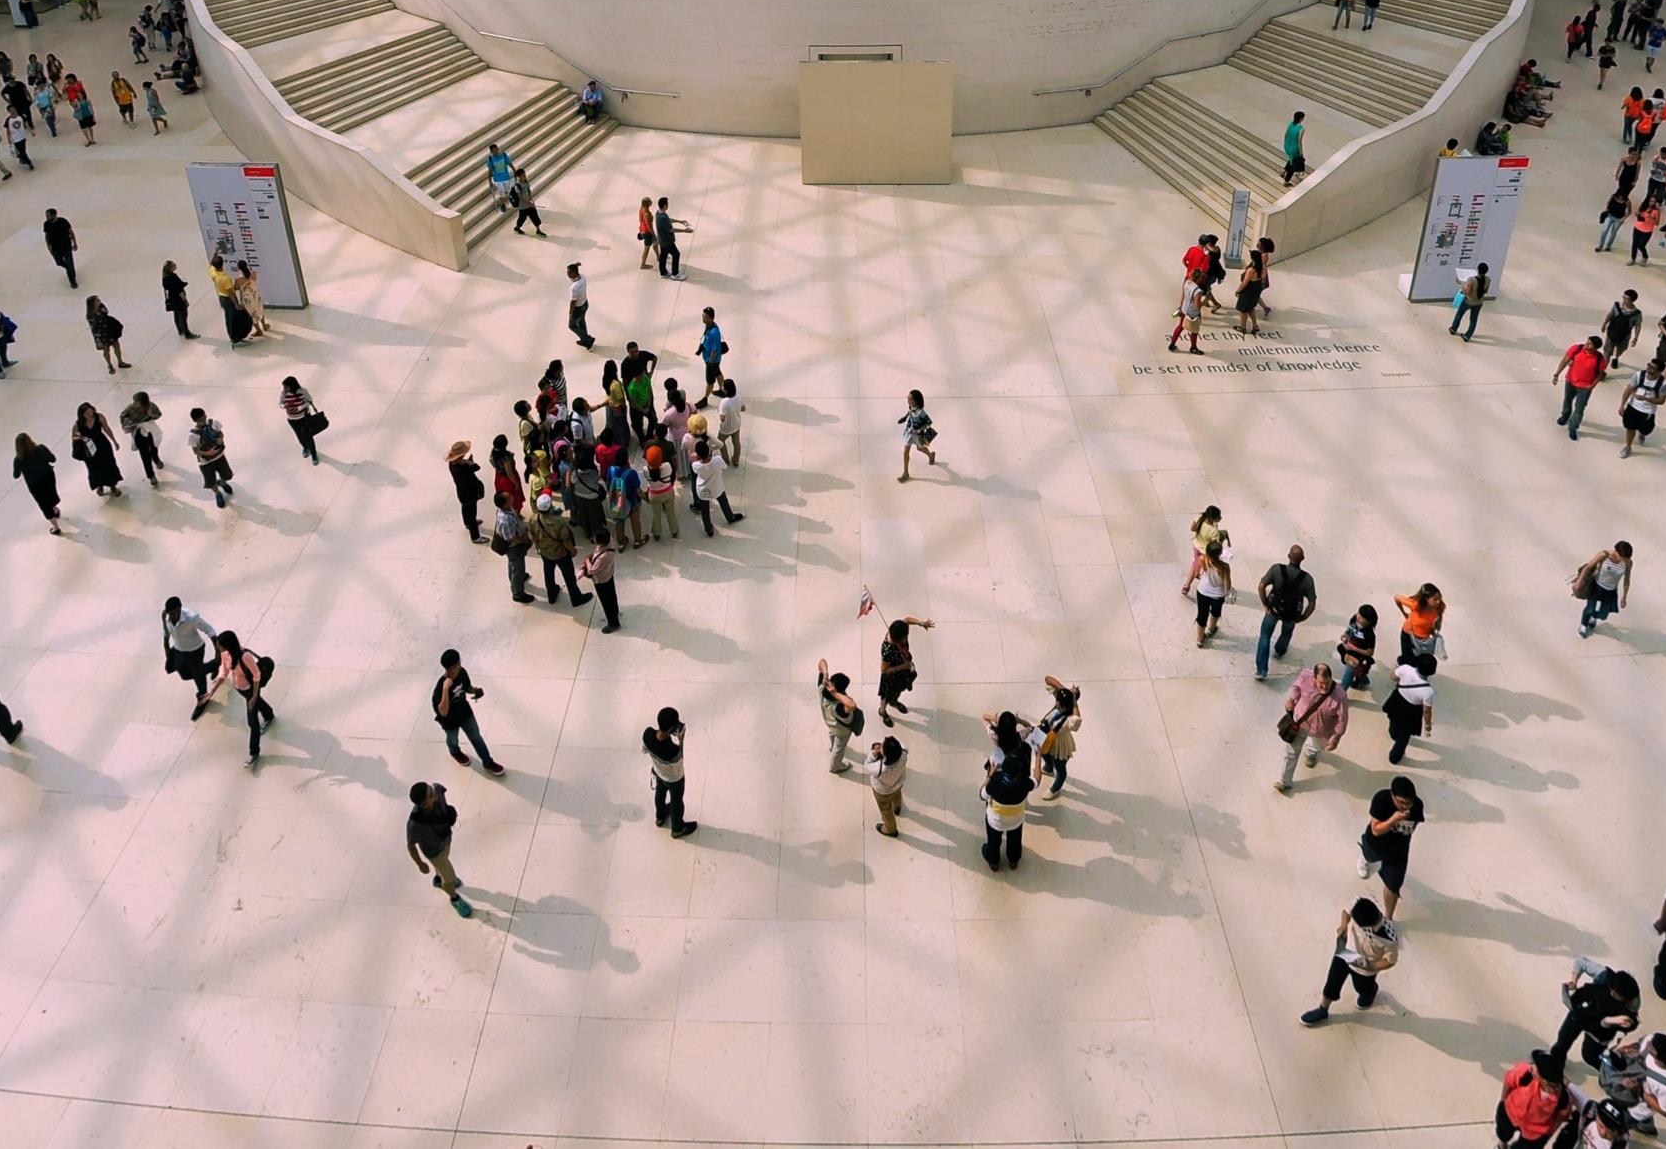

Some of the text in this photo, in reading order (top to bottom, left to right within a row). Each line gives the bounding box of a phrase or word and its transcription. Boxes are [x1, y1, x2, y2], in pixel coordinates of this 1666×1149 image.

[1222, 330, 1246, 342] thy
[1238, 343, 1381, 357] millenniums hence
[1132, 358, 1362, 375] be set in midst of knowledge
